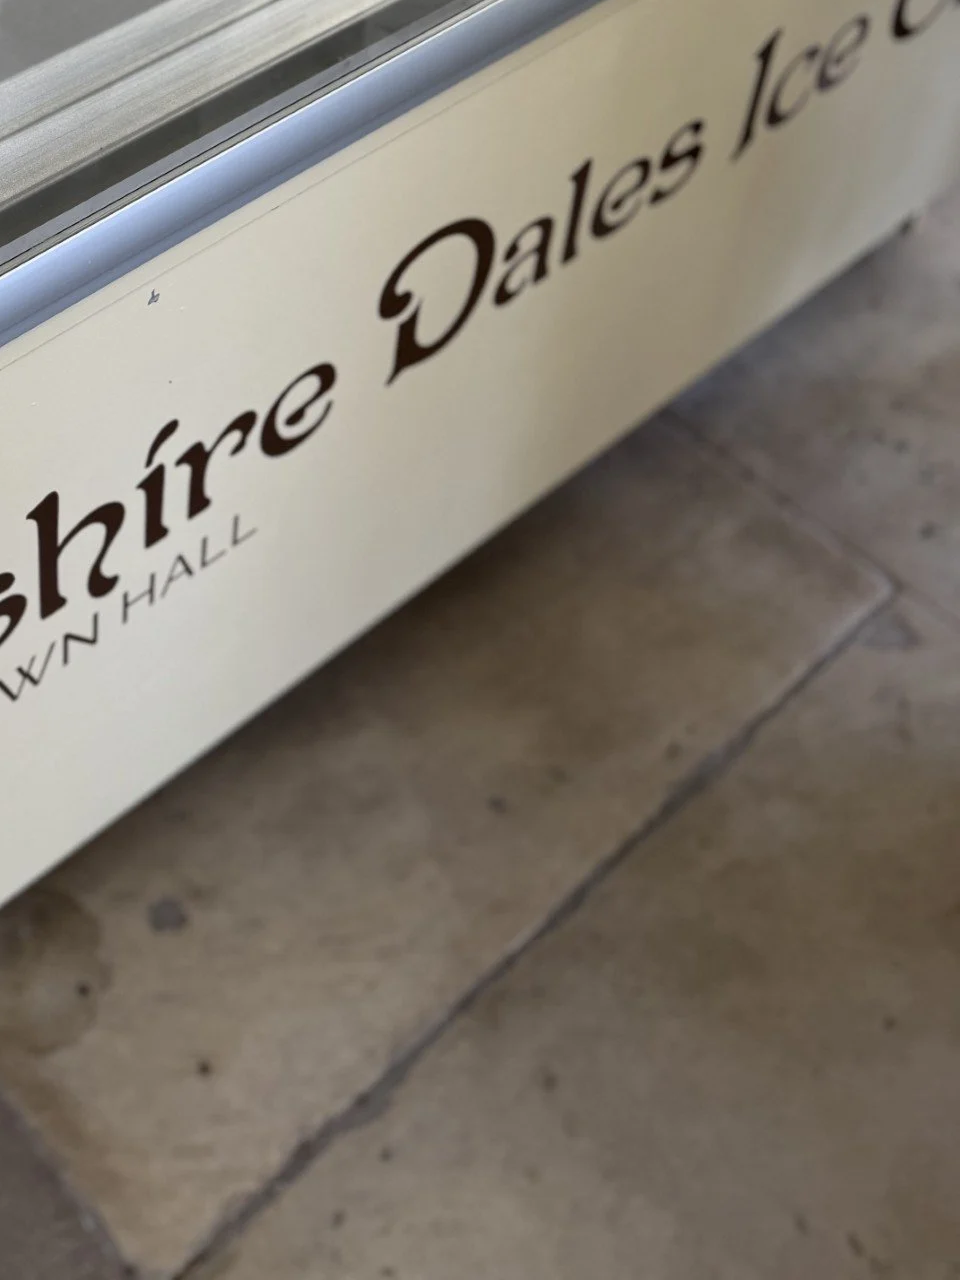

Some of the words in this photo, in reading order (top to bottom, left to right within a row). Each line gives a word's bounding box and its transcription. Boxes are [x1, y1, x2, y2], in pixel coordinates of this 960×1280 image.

[377, 117, 707, 388] Dales
[731, 13, 871, 165] Ice
[121, 512, 259, 626] HALL
